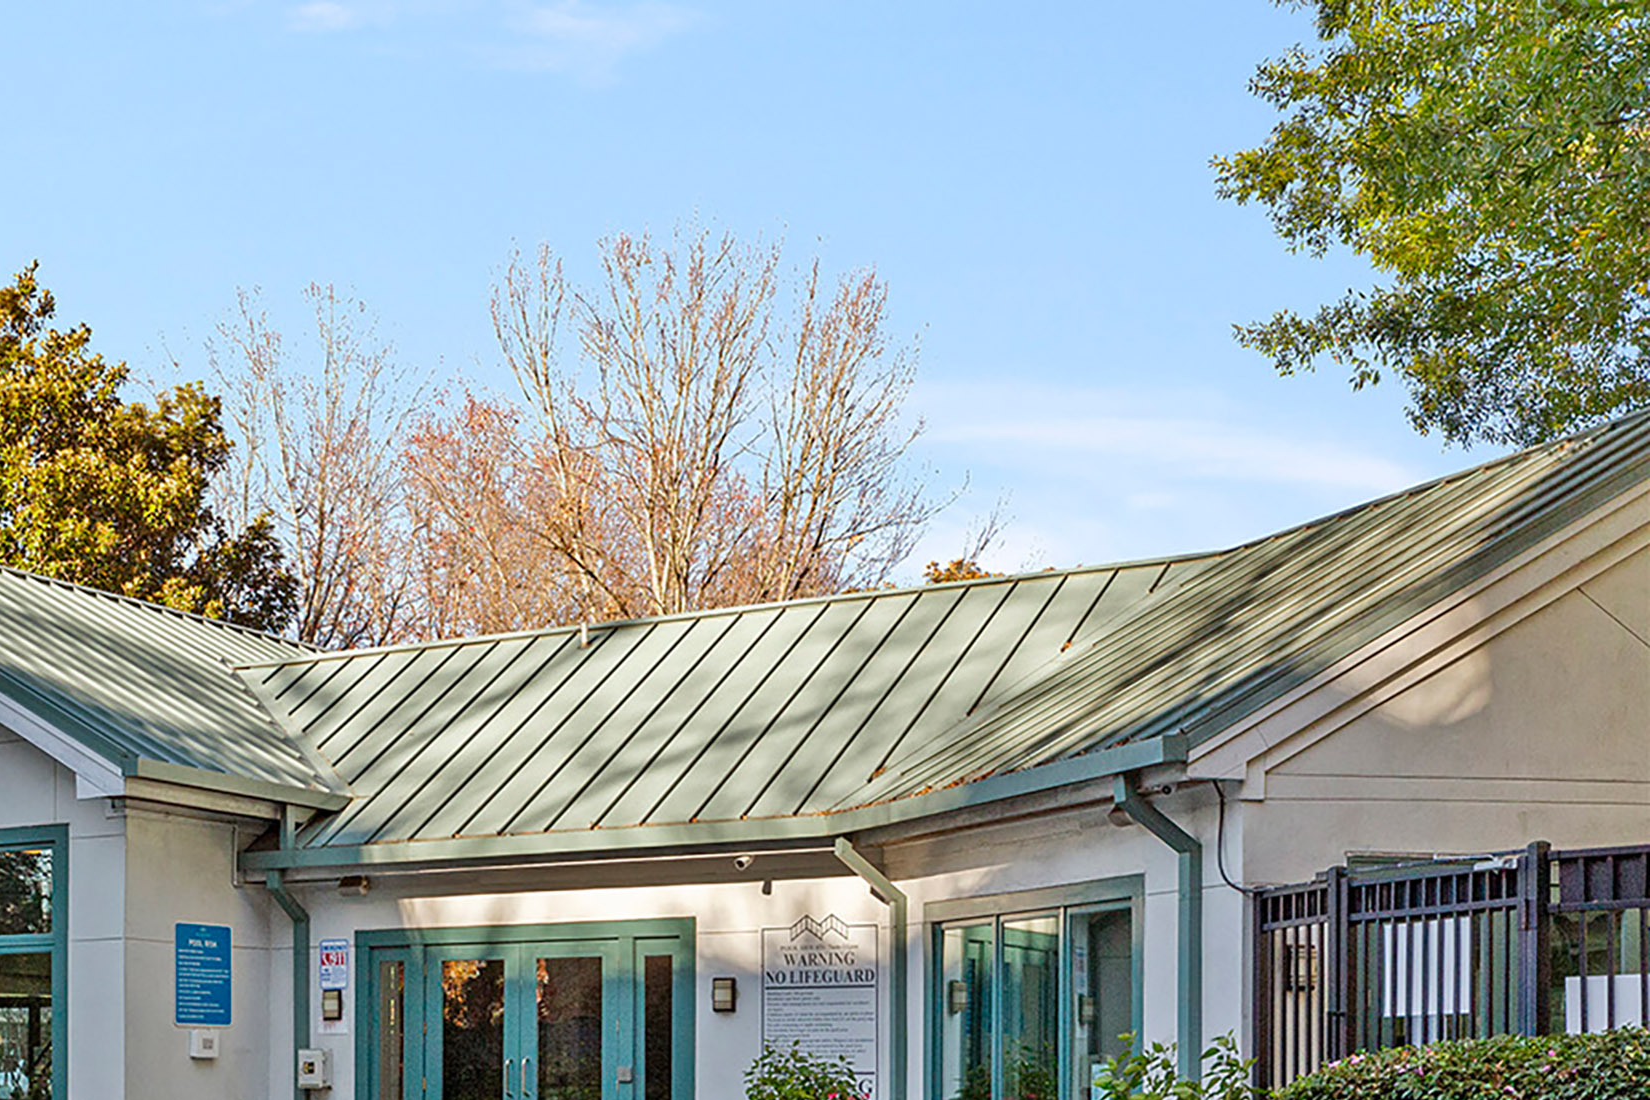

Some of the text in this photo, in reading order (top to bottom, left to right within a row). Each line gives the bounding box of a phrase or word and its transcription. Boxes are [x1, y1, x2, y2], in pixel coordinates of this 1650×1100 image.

[783, 950, 856, 967] WARNING
[765, 967, 876, 985] NO LIFEGUARD
